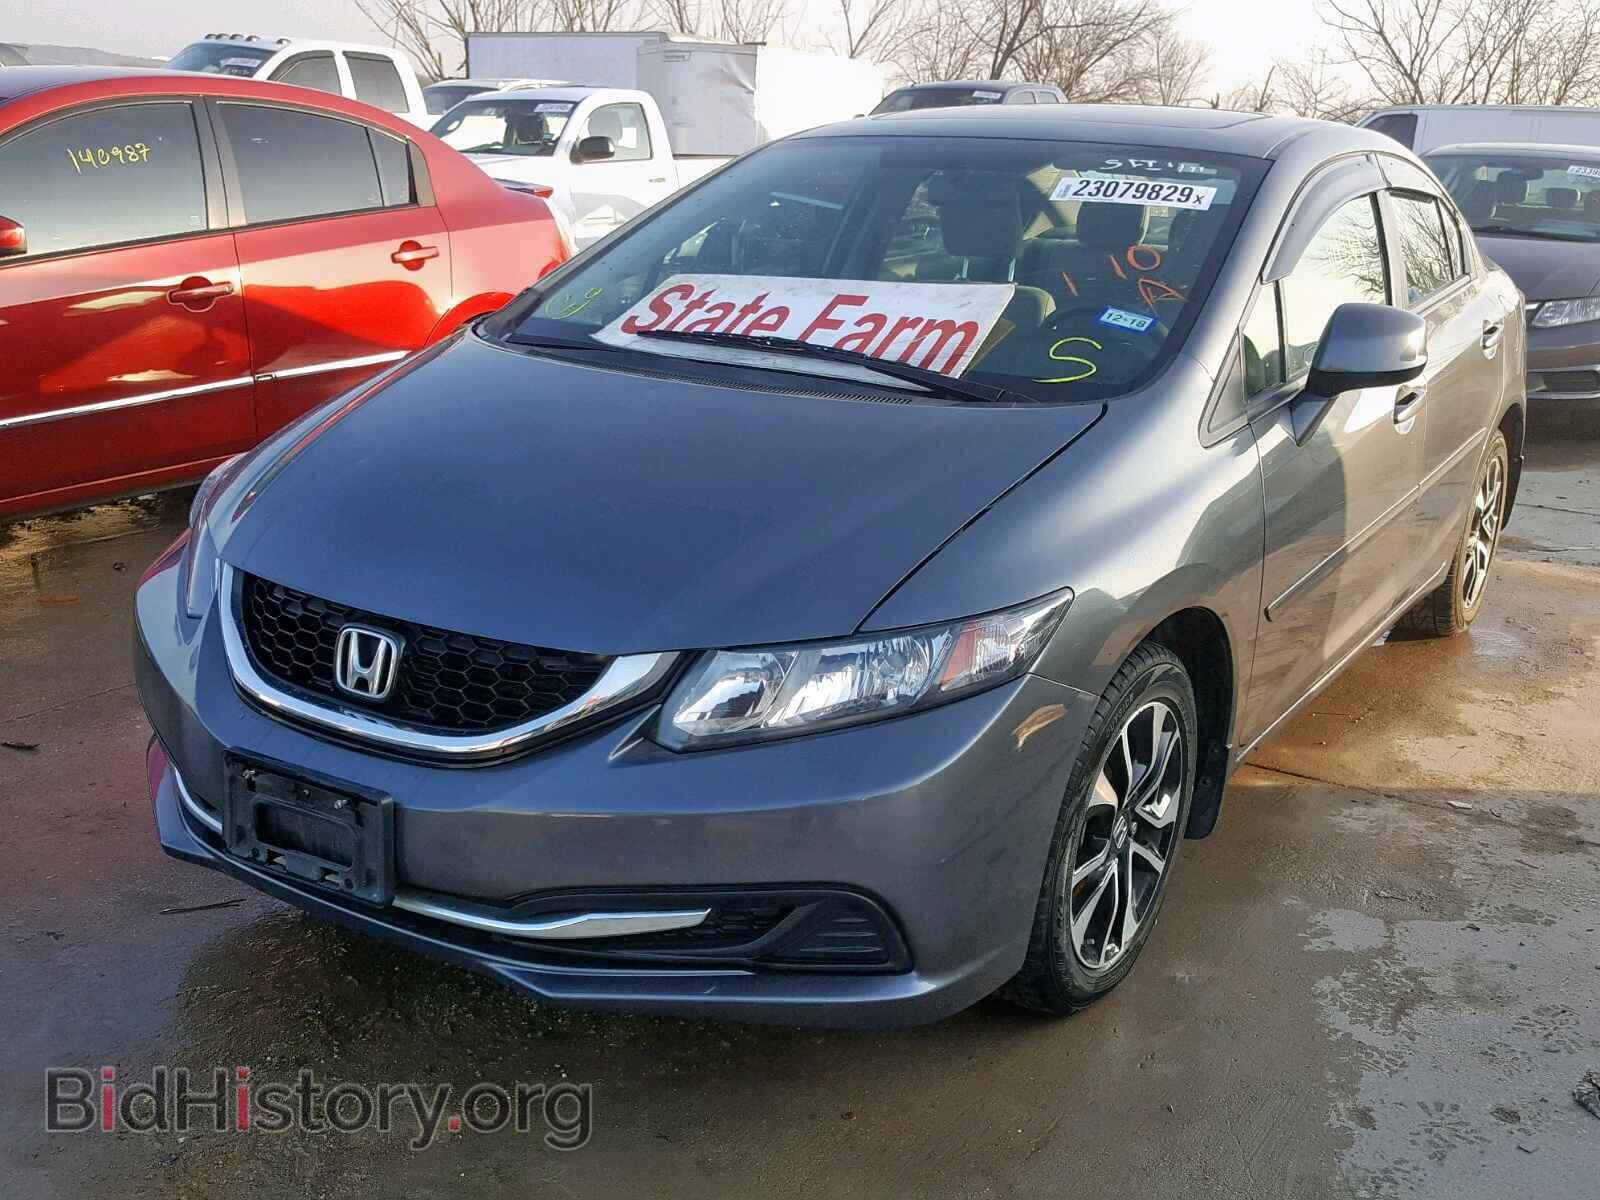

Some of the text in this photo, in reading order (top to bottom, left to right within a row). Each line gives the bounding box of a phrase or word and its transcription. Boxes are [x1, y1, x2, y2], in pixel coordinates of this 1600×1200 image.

[620, 283, 790, 336] State
[798, 293, 980, 377] Farm
[1032, 337, 1102, 383] S
